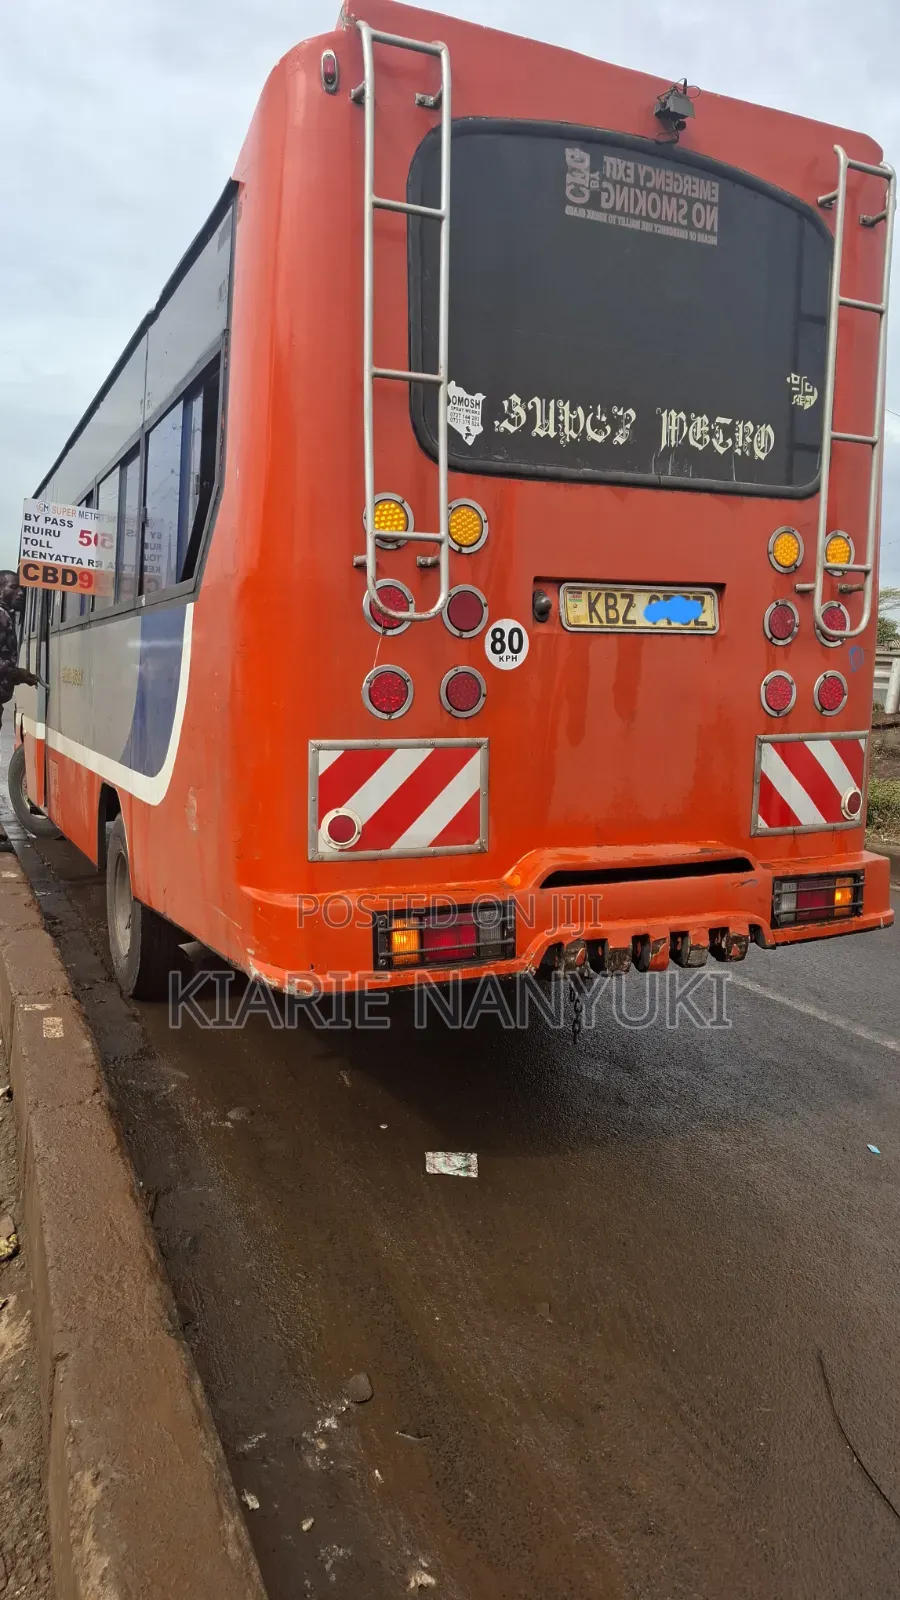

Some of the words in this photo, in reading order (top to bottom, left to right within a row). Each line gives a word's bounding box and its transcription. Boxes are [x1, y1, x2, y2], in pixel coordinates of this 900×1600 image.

[451, 395, 481, 409] OMOSH
[51, 505, 77, 518] SUPER
[24, 513, 41, 523] BY
[44, 516, 74, 528] PASS
[23, 525, 61, 538] RUIRU
[23, 537, 53, 549] TOLL
[22, 549, 84, 566] KENYATTA
[587, 591, 637, 625] KBZ
[490, 627, 524, 655] 80
[498, 655, 518, 663] KPH
